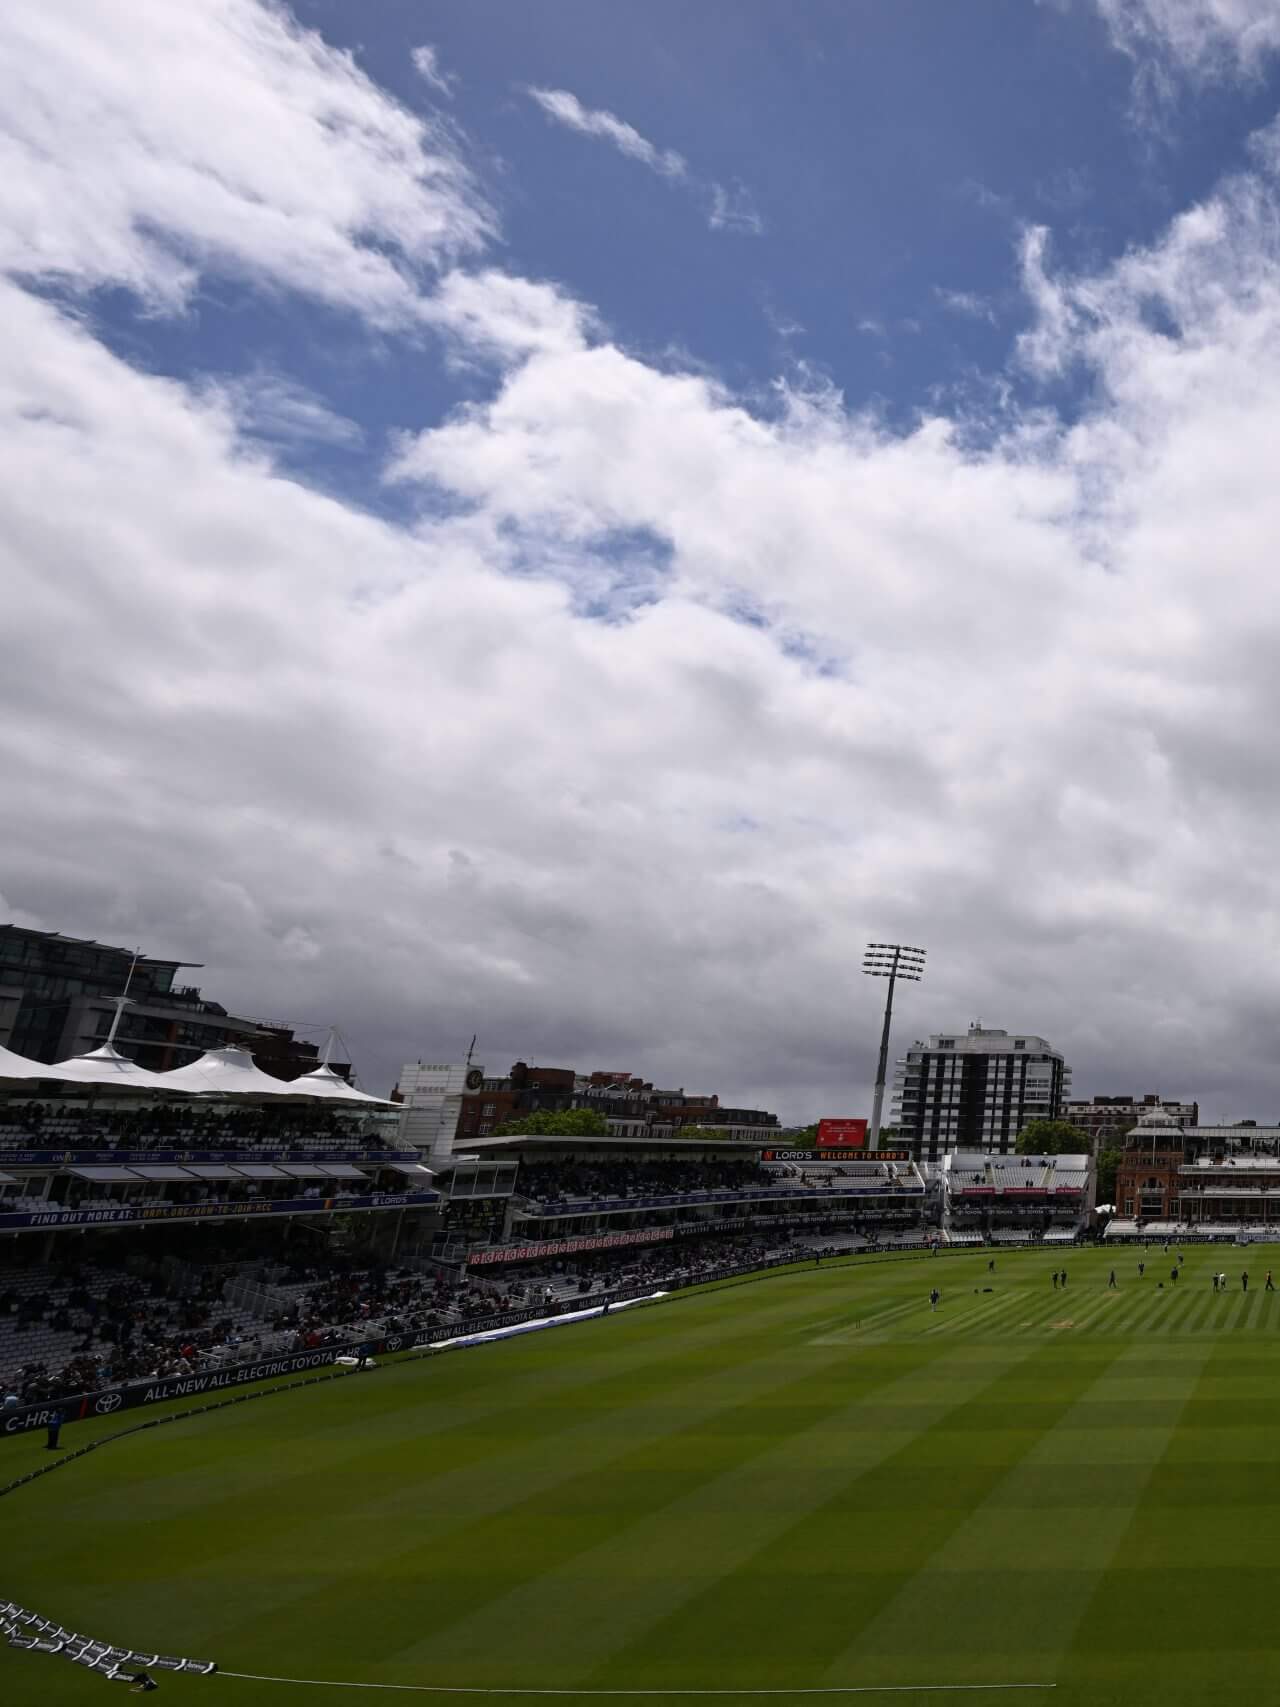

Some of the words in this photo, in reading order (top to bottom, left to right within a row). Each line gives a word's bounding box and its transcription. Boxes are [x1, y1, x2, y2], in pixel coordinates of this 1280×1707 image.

[776, 1151, 813, 1161] LORD'S
[820, 1152, 858, 1160] WELCOME
[862, 1152, 872, 1160] TO
[30, 1214, 57, 1225] FIND
[61, 1212, 83, 1224] OUT
[87, 1210, 116, 1223] MORE
[472, 1255, 480, 1264] IG
[483, 1253, 493, 1262] IG
[495, 1252, 504, 1262] IG
[506, 1250, 516, 1260] IG
[518, 1248, 527, 1258] IG
[529, 1248, 537, 1256] IG
[538, 1246, 547, 1255] IG
[549, 1244, 558, 1254] IG
[559, 1244, 568, 1252] IG
[414, 1327, 452, 1345] ALL-NEW
[453, 1317, 500, 1337] ALL-ELECTRIC
[501, 1312, 528, 1328] TOYOTA
[144, 1378, 208, 1402] ALL-NEW
[210, 1362, 289, 1387] ALL-ELECTRIC
[290, 1352, 336, 1370] TOYOTA
